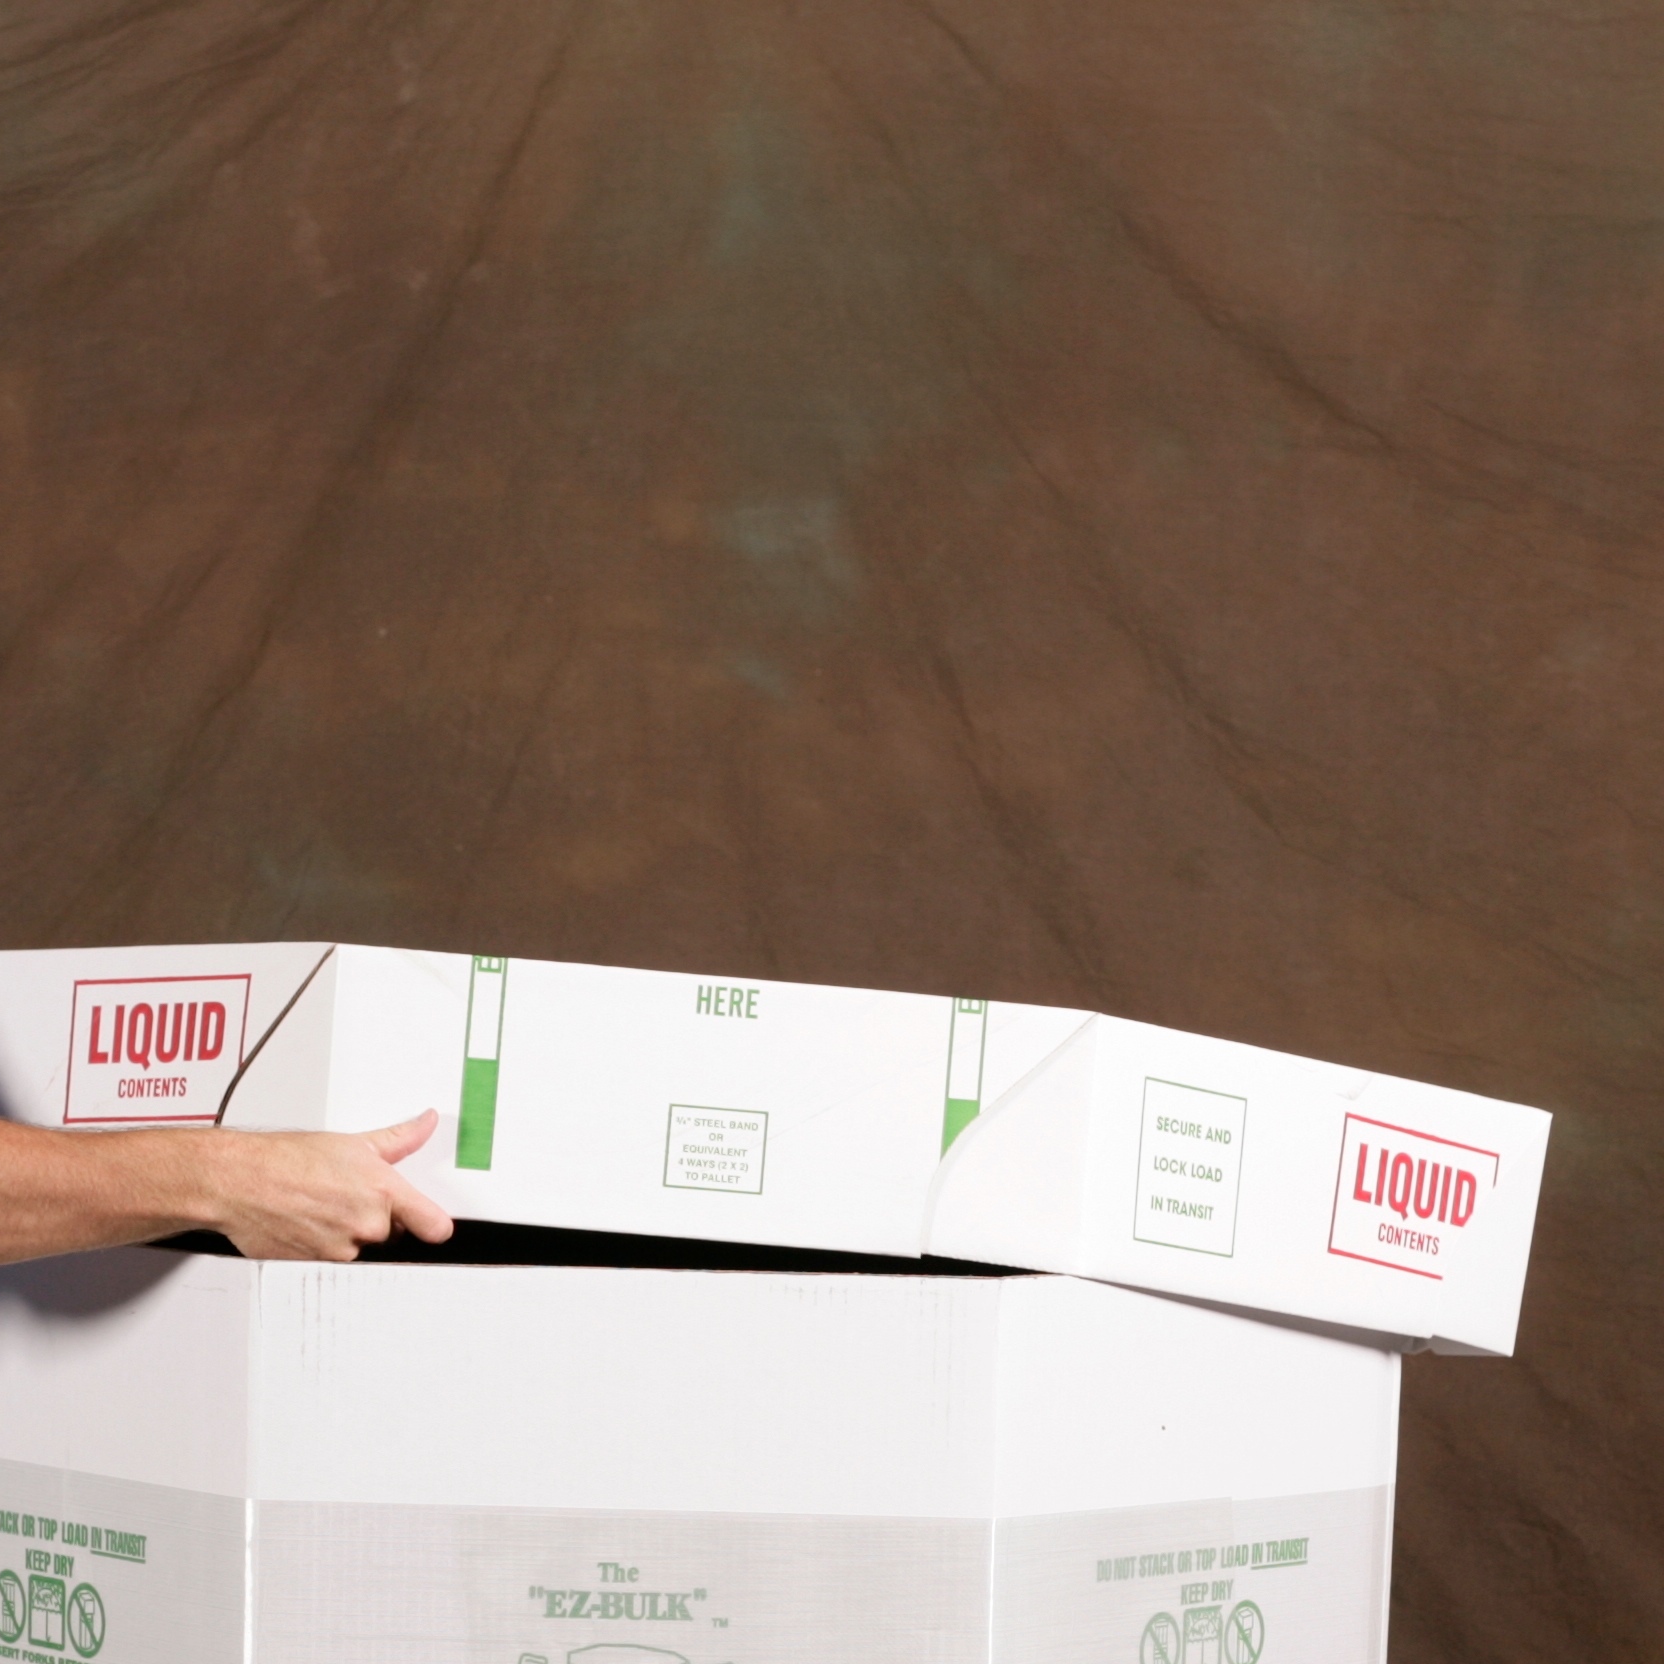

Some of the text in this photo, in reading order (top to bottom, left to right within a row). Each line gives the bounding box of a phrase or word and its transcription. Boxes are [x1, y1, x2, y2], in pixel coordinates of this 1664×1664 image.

[696, 985, 761, 1019] HERE
[87, 1001, 226, 1071] LIQUID
[117, 1077, 187, 1099] CONTENTS
[694, 1118, 726, 1129] STEEL
[729, 1120, 759, 1131] BAND
[708, 1132, 724, 1142] OR
[1156, 1115, 1232, 1146] SECURE AND
[678, 1158, 684, 1166] 4
[687, 1158, 716, 1169] WAYS
[682, 1144, 748, 1157] EQUIVALENT
[685, 1171, 741, 1184] TO PALLET
[1153, 1155, 1223, 1184] LOCK LOAD
[1353, 1142, 1478, 1228] LIQUID
[1150, 1195, 1214, 1221] IN TRANSIT
[1377, 1222, 1440, 1257] CONTENTS
[21, 1514, 35, 1539] OR
[37, 1517, 58, 1541] TOP
[61, 1521, 88, 1547] LOAD
[90, 1527, 102, 1551] IN
[104, 1528, 147, 1559] TRANSIT
[25, 1548, 75, 1578] KEEP DRY
[597, 1562, 640, 1583] The
[1096, 1537, 1309, 1583] DO NOT STACK OR TOP LOAD IN TRANSIT
[1180, 1579, 1234, 1606] KEEP DRY
